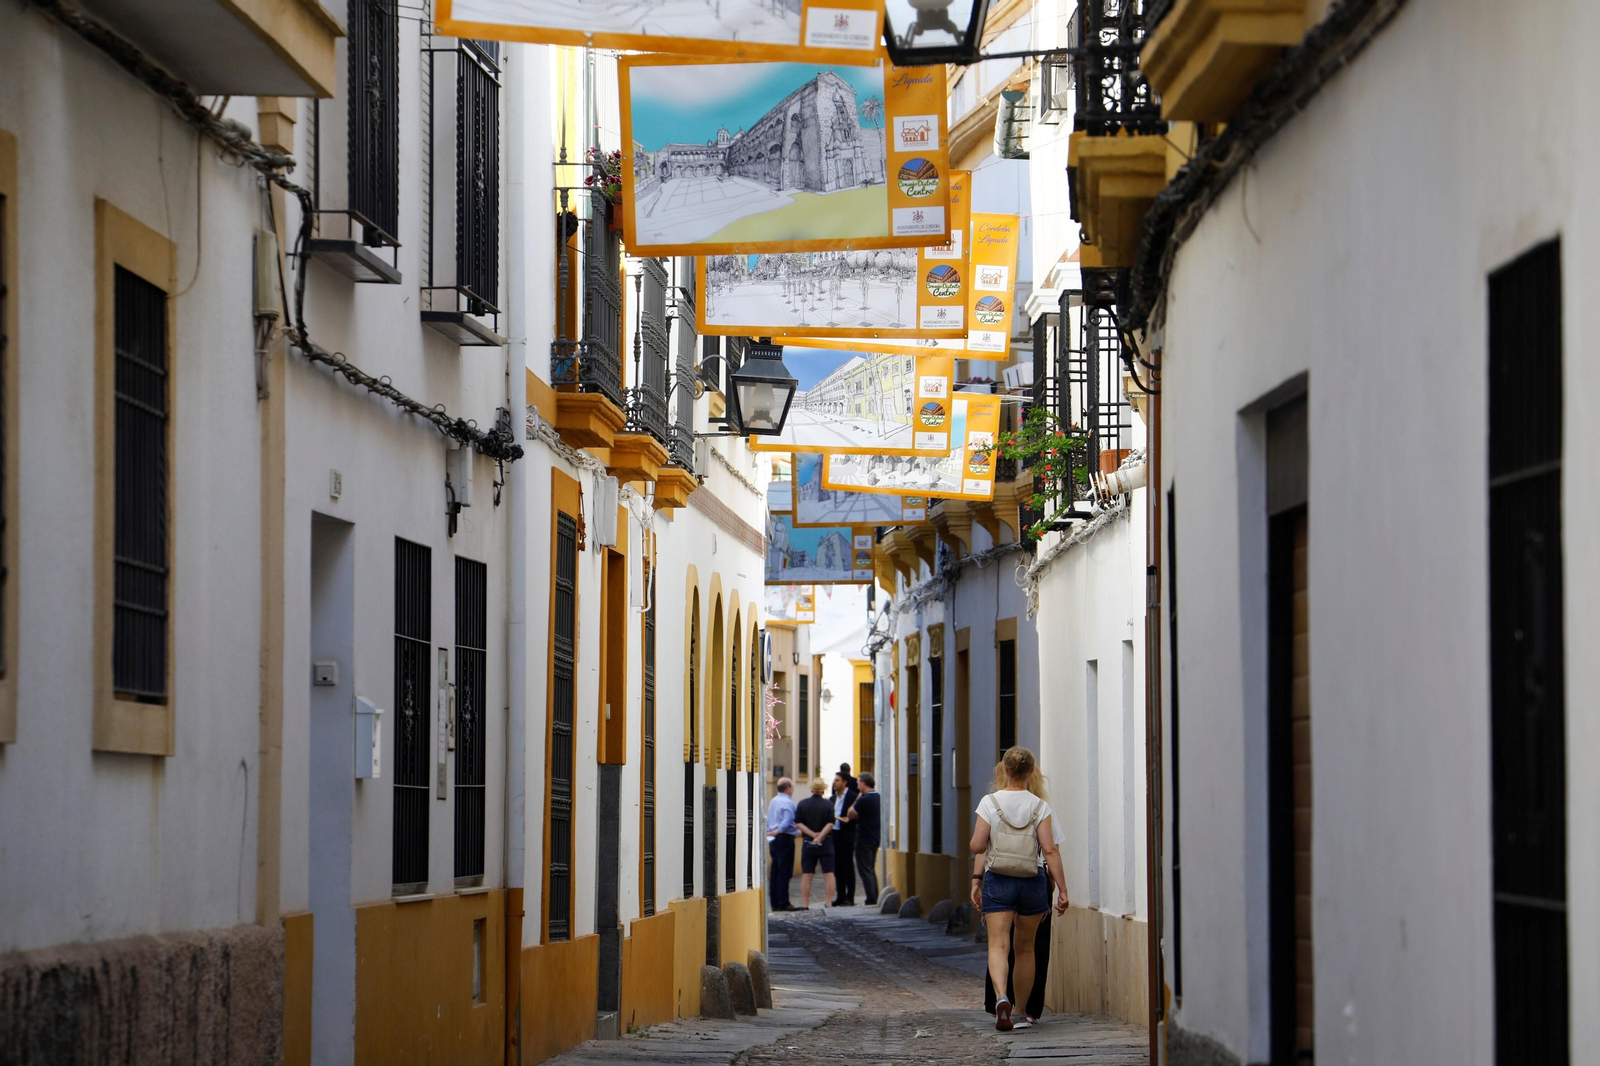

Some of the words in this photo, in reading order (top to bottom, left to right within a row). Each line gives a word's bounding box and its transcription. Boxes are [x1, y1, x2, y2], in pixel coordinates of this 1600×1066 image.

[897, 180, 917, 188] Consejo
[917, 179, 939, 187] Distrito
[906, 186, 935, 197] Centro
[932, 288, 956, 297] Centro
